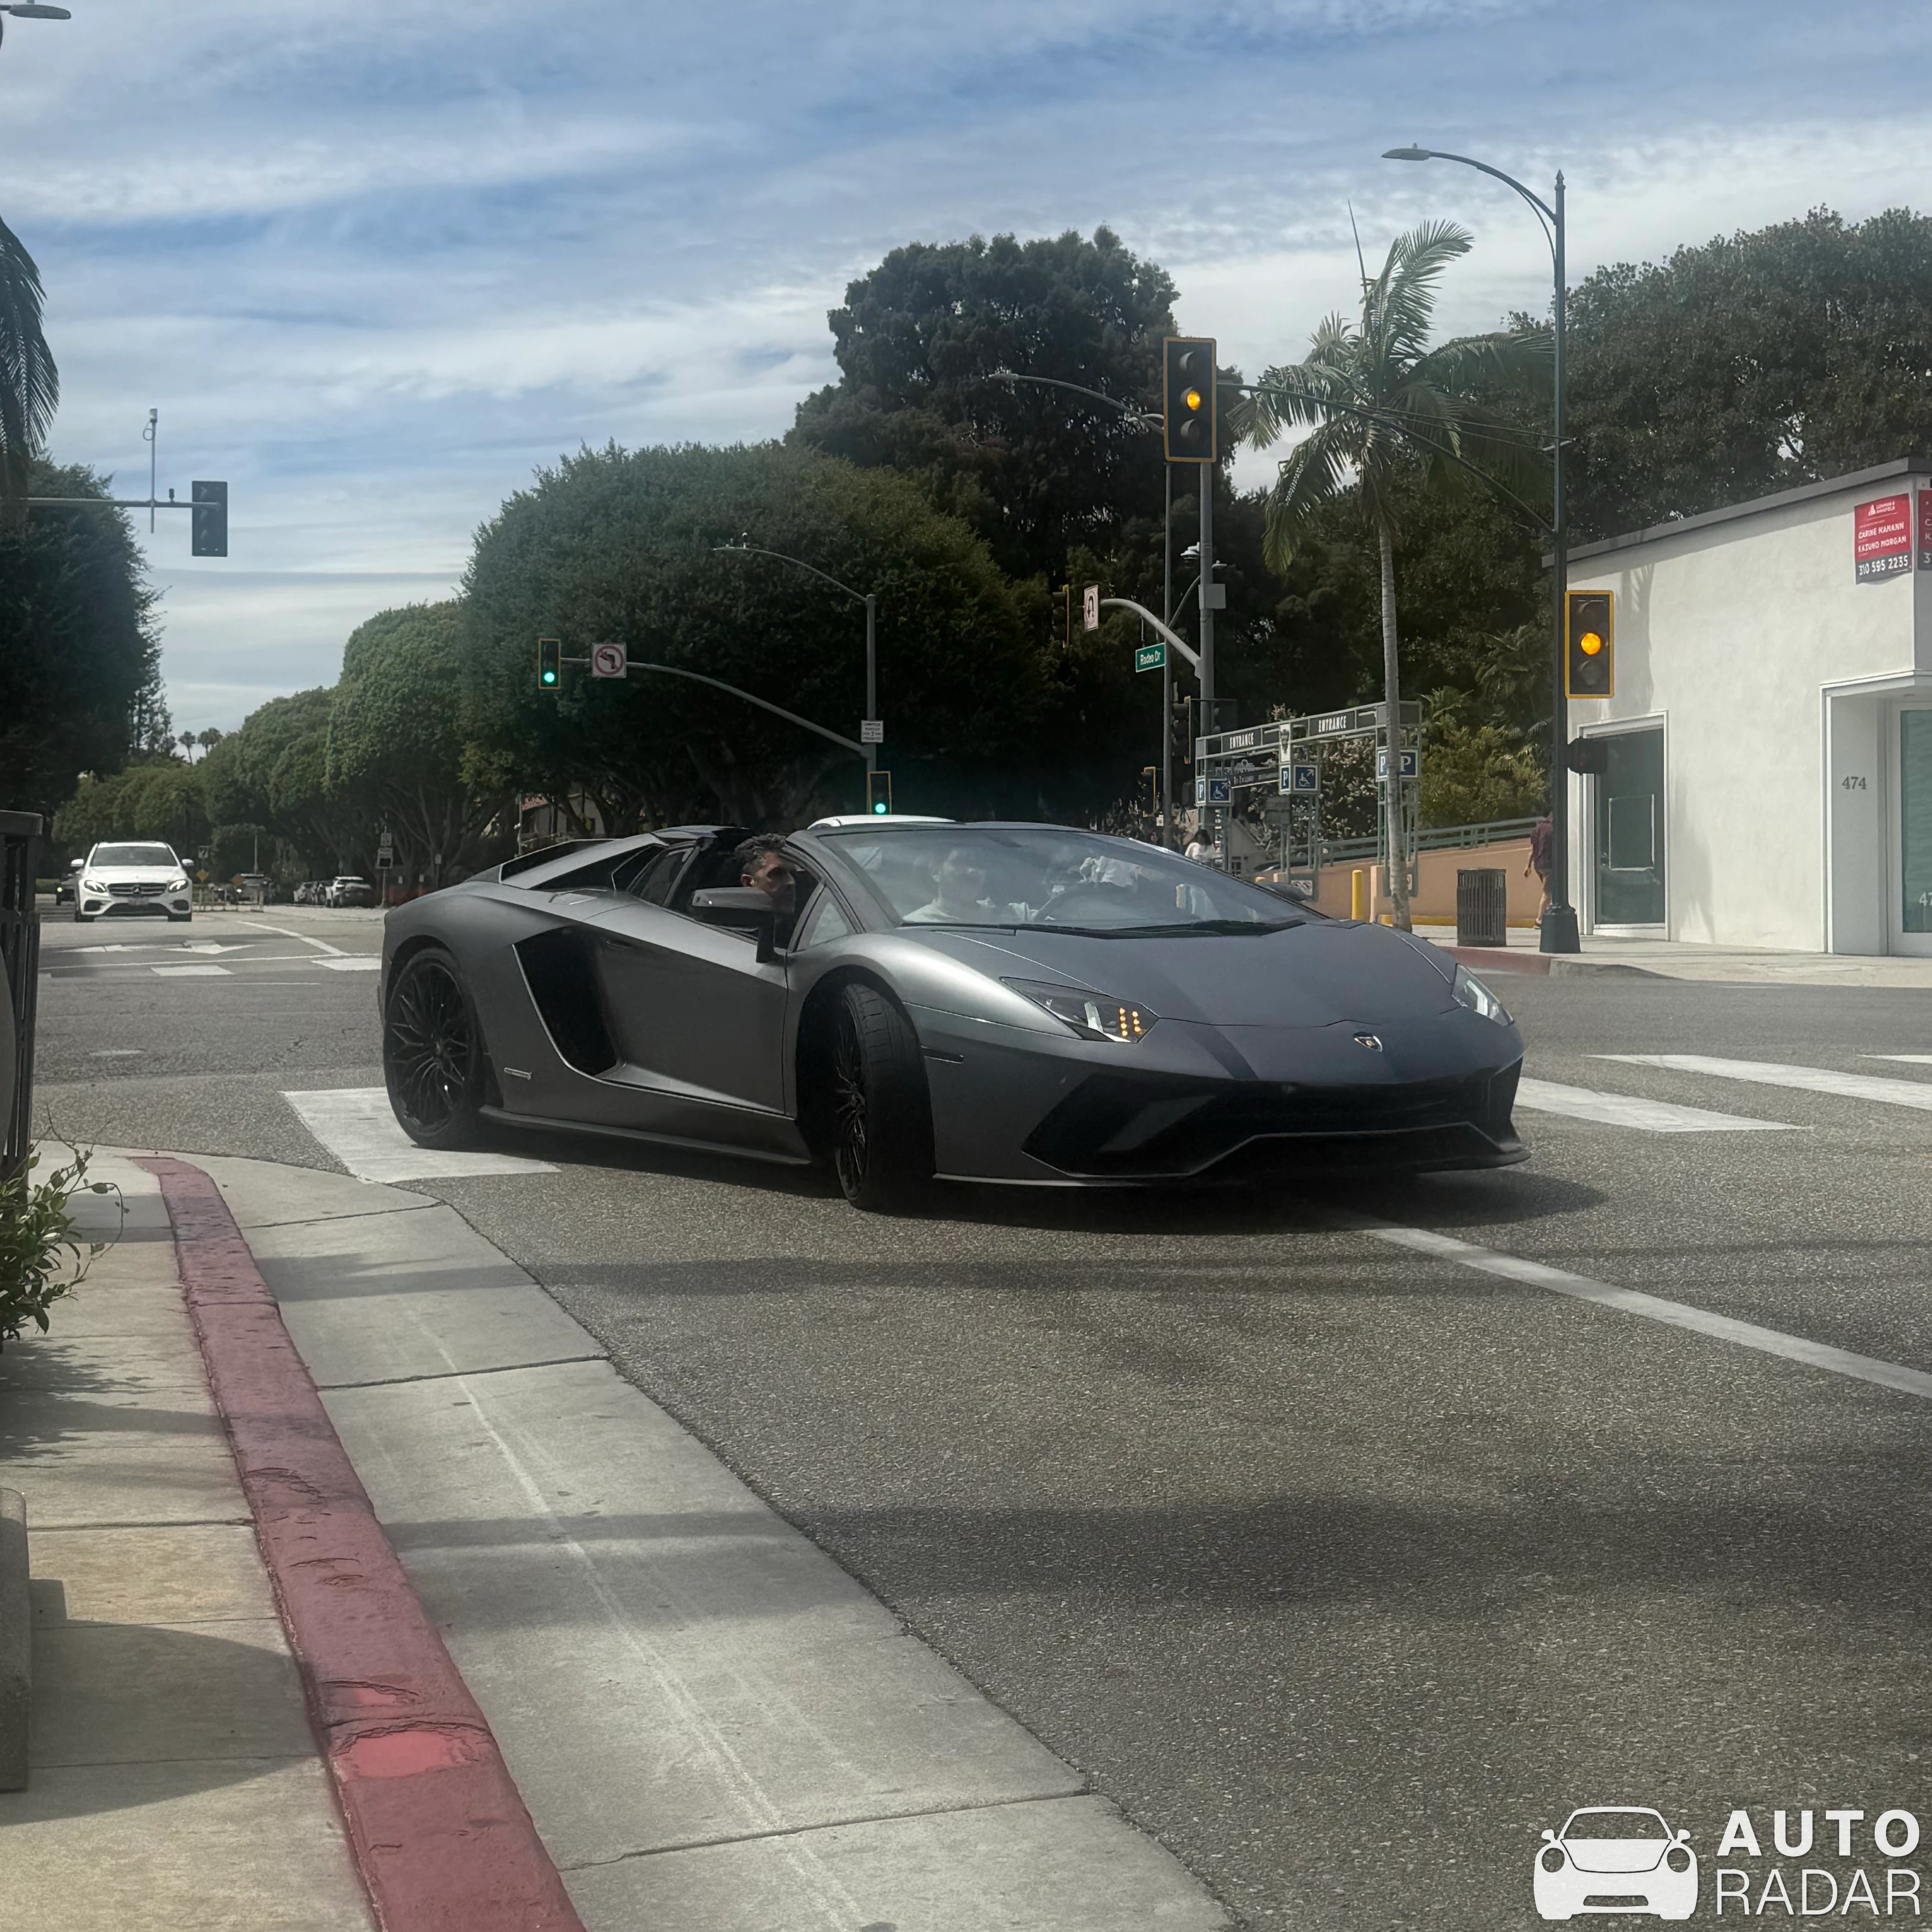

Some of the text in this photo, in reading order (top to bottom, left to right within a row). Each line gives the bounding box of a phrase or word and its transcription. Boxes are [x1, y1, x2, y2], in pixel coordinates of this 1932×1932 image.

[1880, 535, 1907, 548] MORGAN
[1858, 563, 1869, 576] 310
[1872, 559, 1886, 572] 595
[1888, 555, 1908, 569] 2235
[1140, 650, 1161, 665] Rodeo Dr
[1318, 715, 1347, 733] ENTRANCE
[1229, 732, 1254, 749] ENTRANCE
[1380, 756, 1385, 773] P
[1400, 755, 1411, 772] P
[1282, 771, 1288, 786] P
[1842, 776, 1867, 789] 474
[1199, 784, 1203, 798] P
